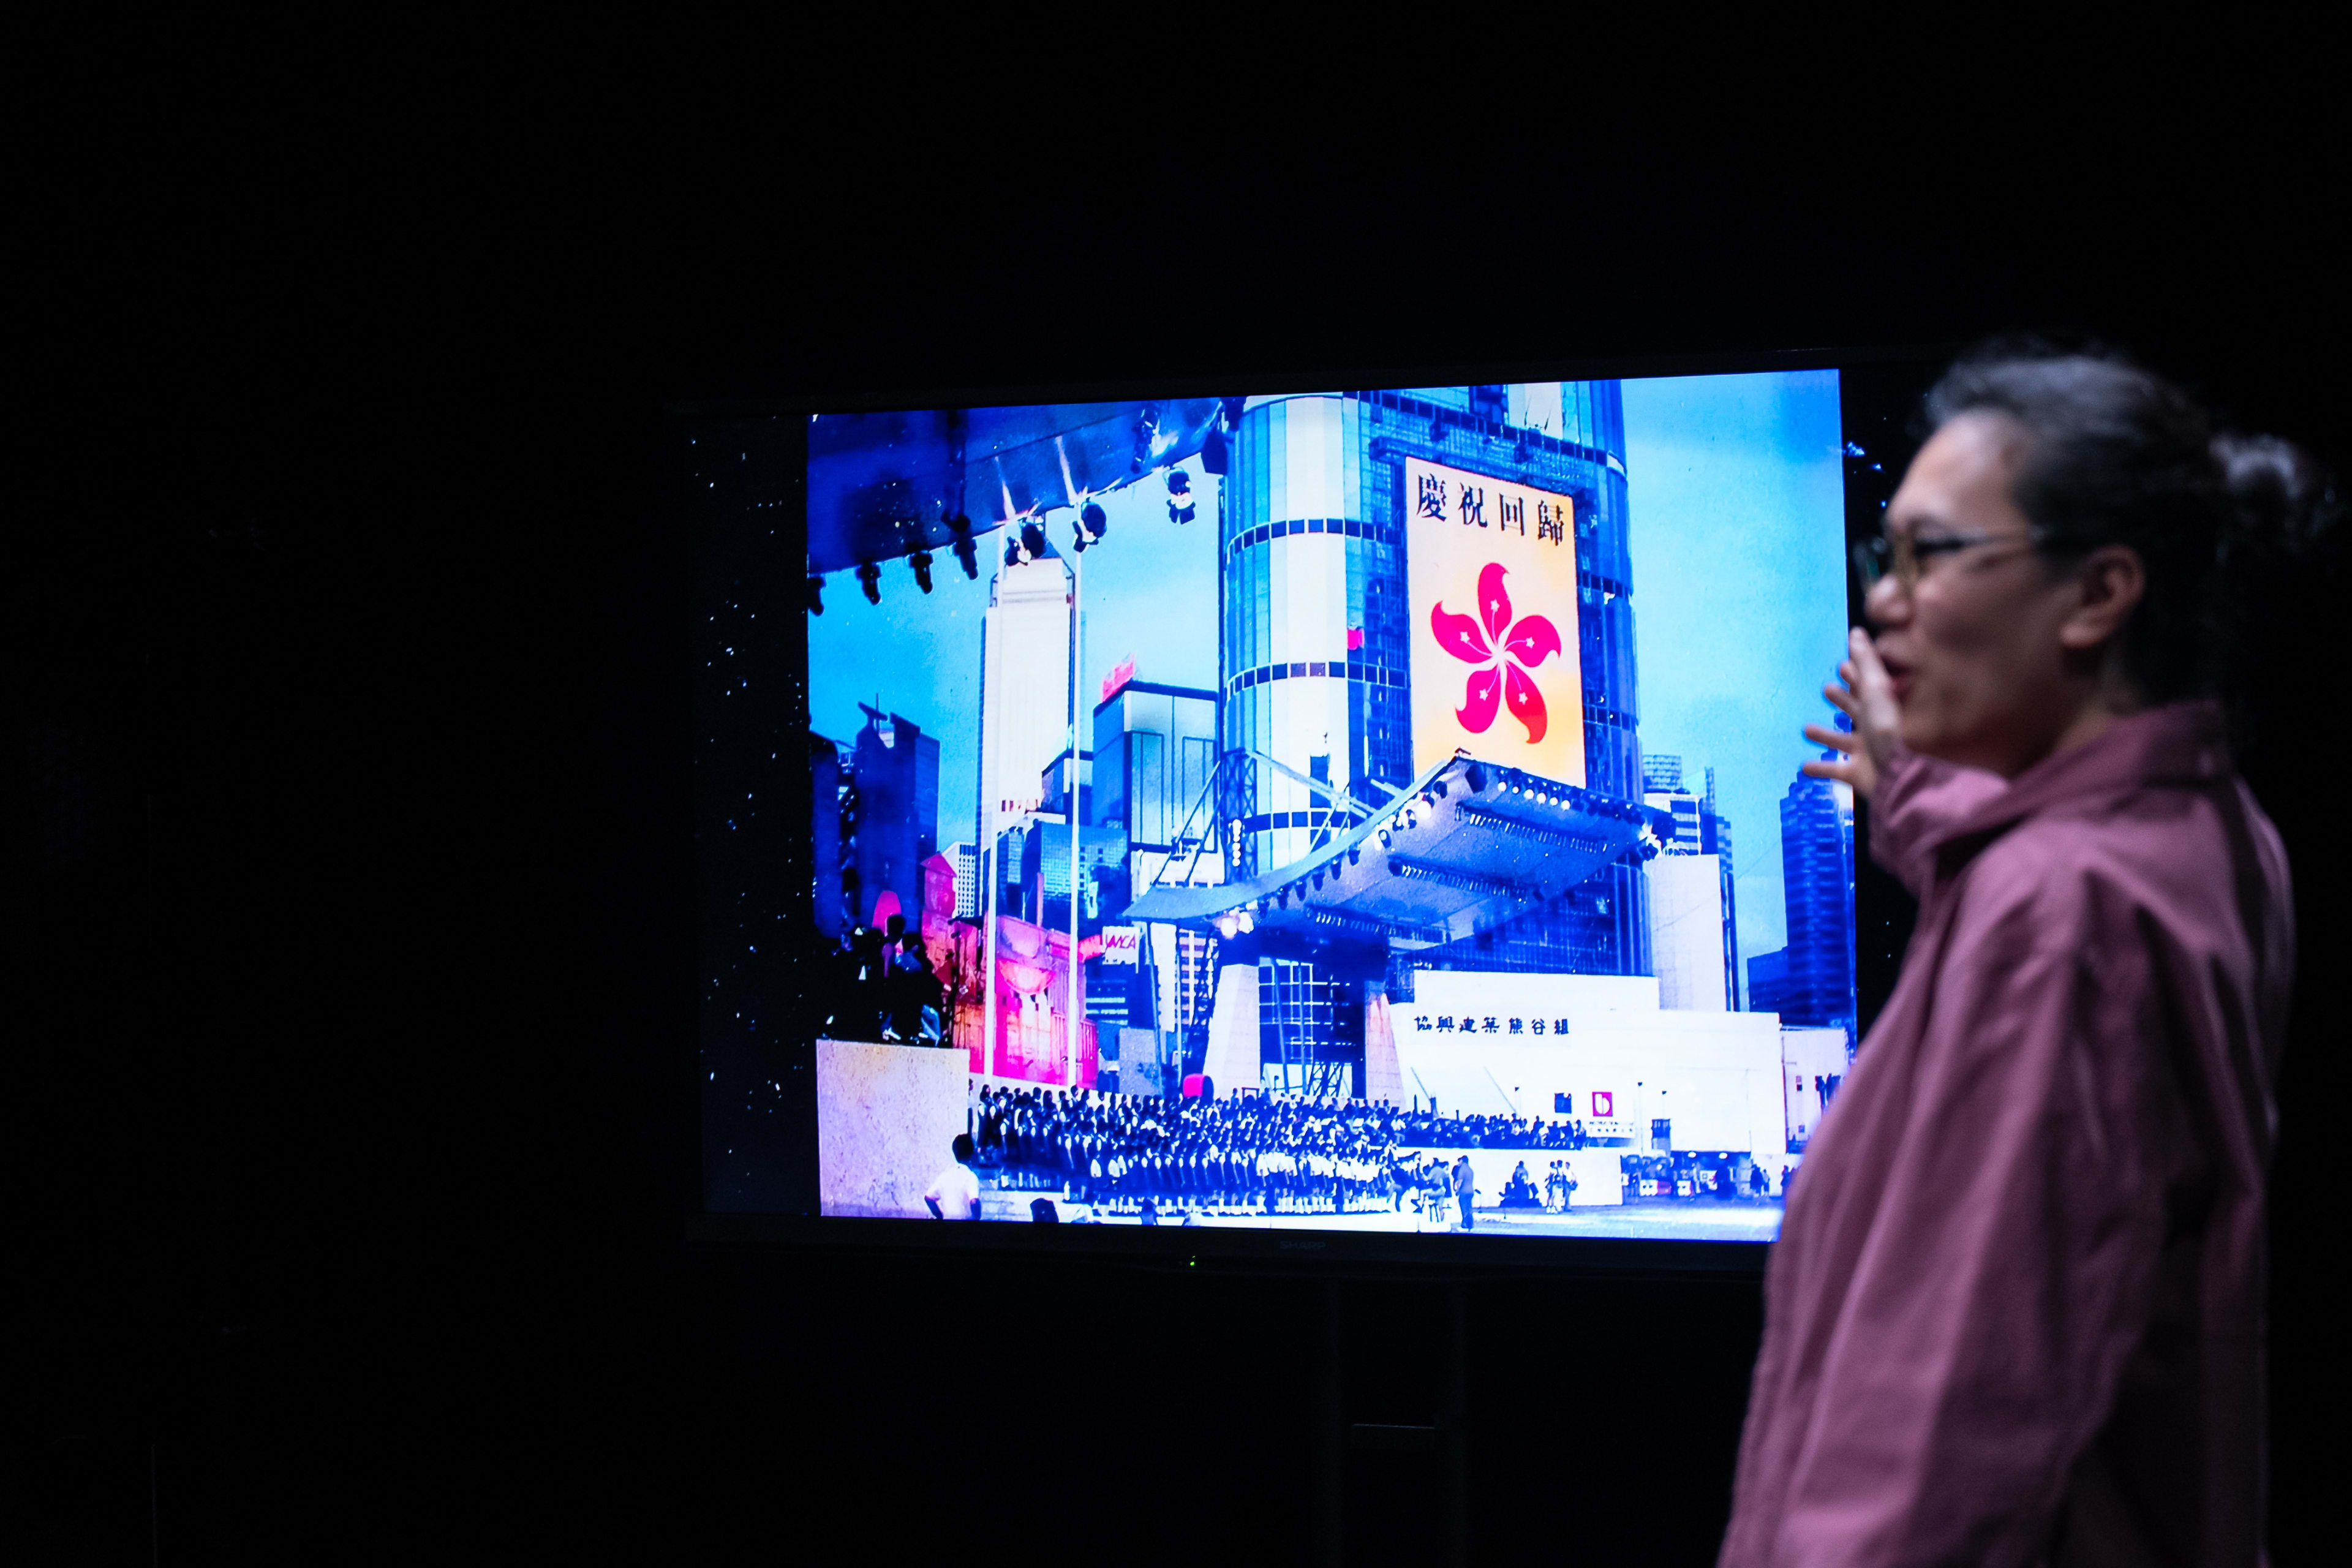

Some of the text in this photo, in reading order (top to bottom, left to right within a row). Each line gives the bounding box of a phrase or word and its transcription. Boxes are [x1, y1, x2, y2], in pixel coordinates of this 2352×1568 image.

[1416, 473, 1564, 546] 慶祝回歸
[1280, 1240, 1326, 1250] SHARP
